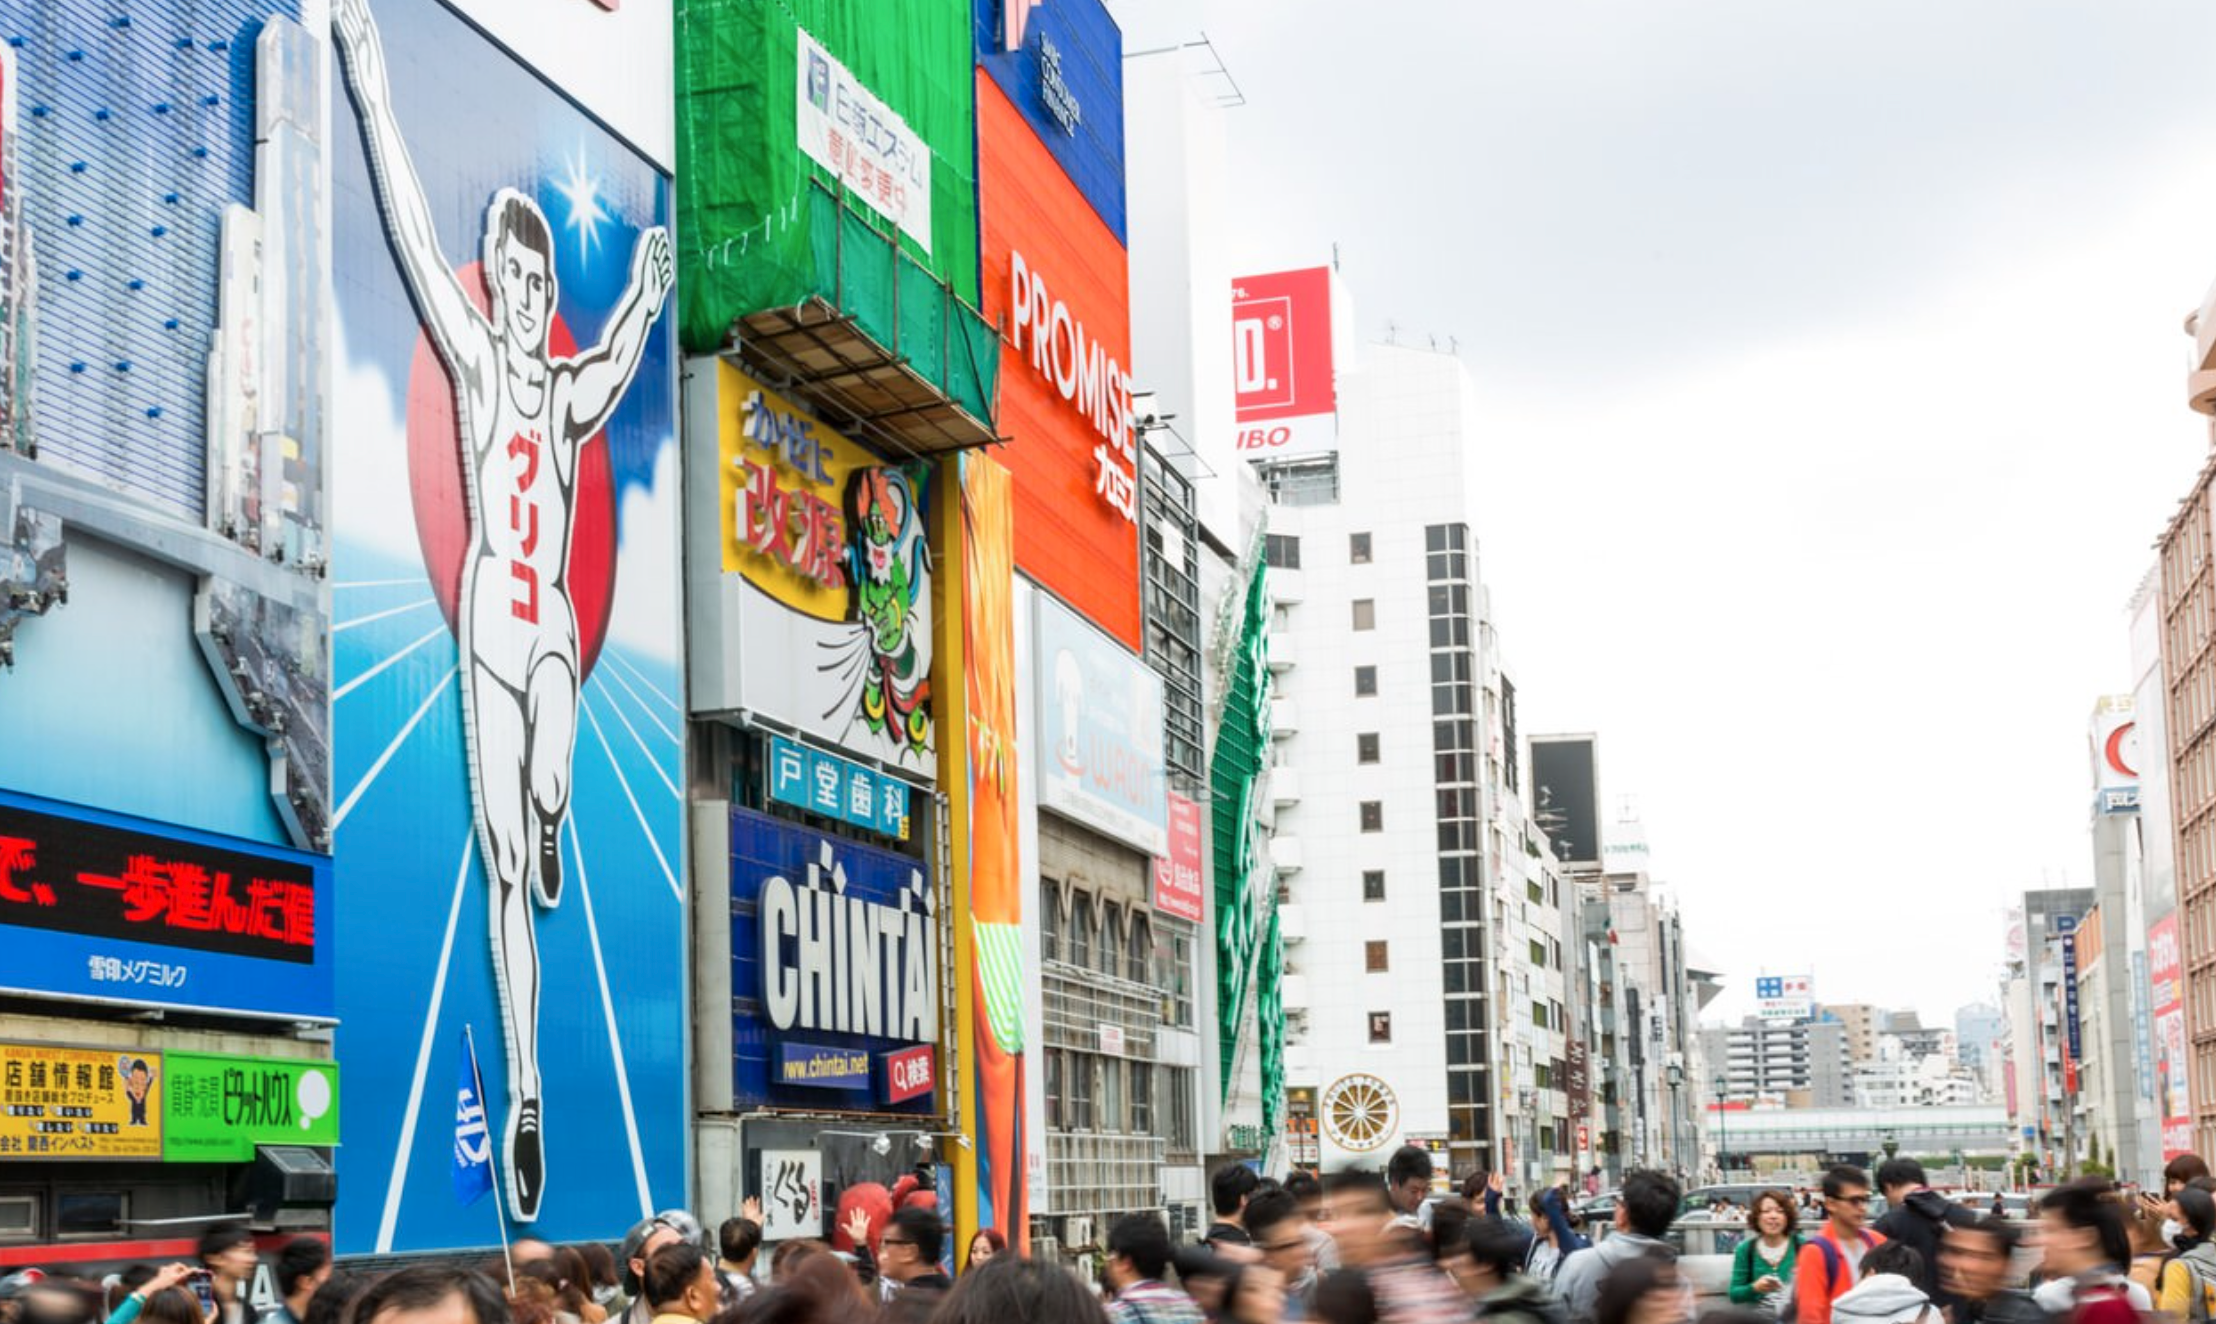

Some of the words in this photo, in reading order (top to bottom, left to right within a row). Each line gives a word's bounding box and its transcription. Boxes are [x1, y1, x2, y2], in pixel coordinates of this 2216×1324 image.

[1011, 249, 1138, 464] PROMISE
[507, 428, 542, 625] グリコ
[734, 455, 845, 590] 改源
[88, 955, 187, 988] 雪印メグミルク
